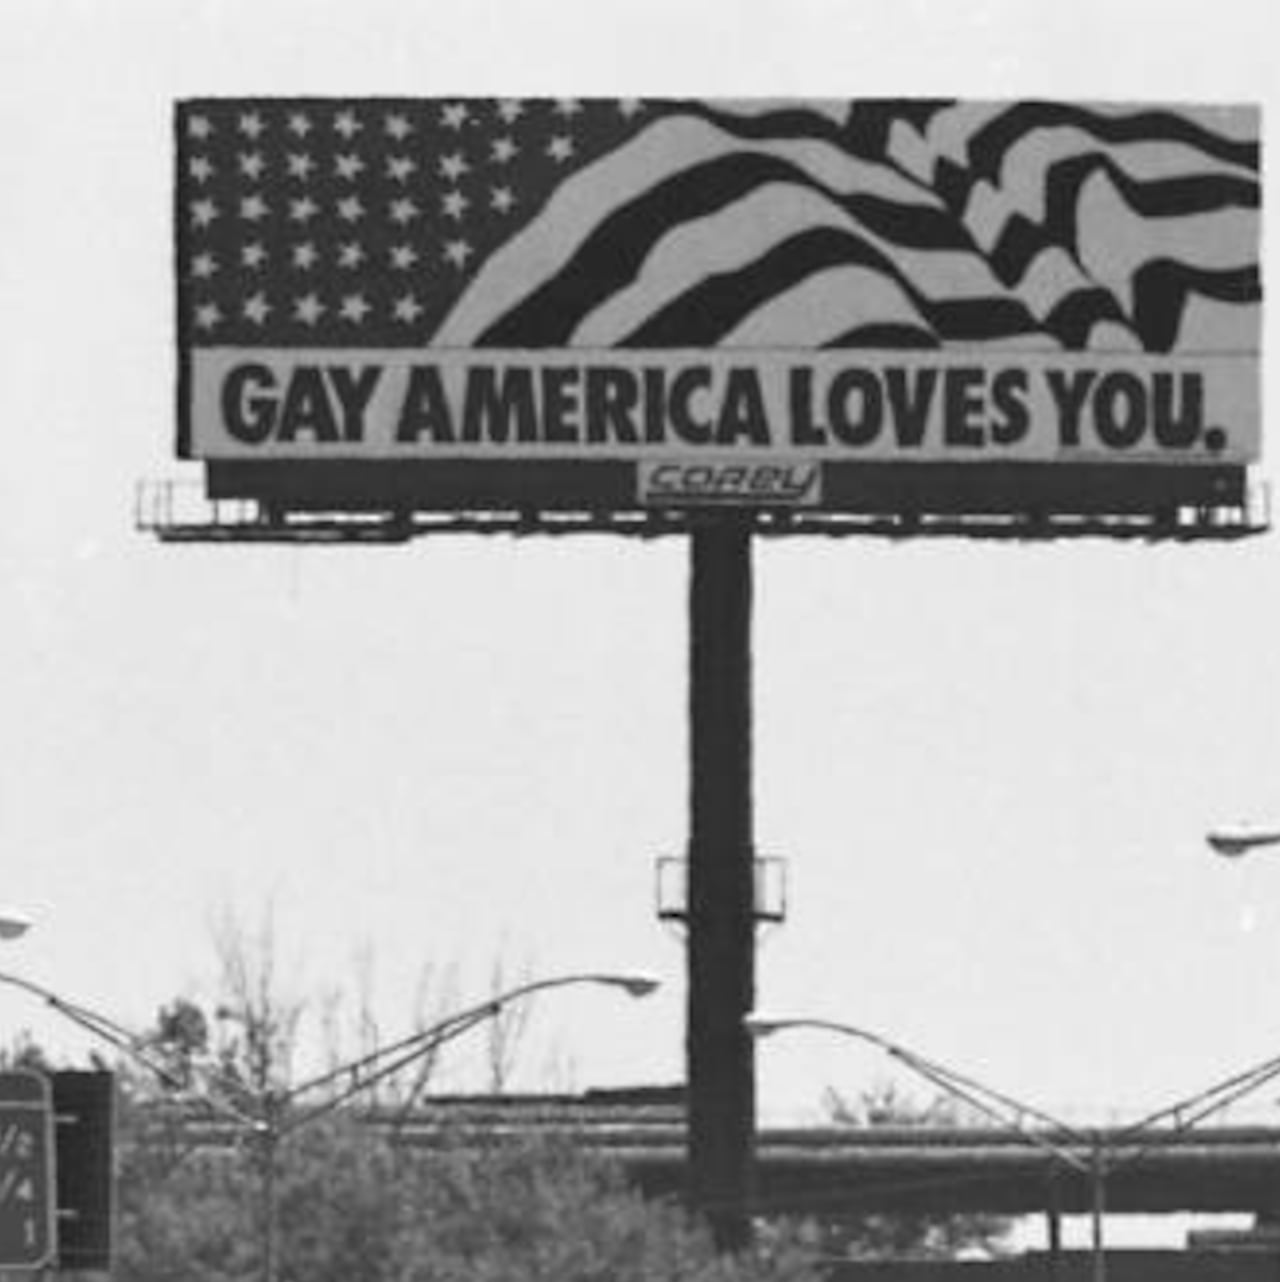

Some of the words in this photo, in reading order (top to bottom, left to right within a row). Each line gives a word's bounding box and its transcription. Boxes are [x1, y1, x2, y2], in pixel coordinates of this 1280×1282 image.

[222, 361, 384, 446] GAY
[394, 363, 773, 447] AMERICA
[789, 365, 1031, 449] LOVES
[1043, 368, 1228, 453] YOU.
